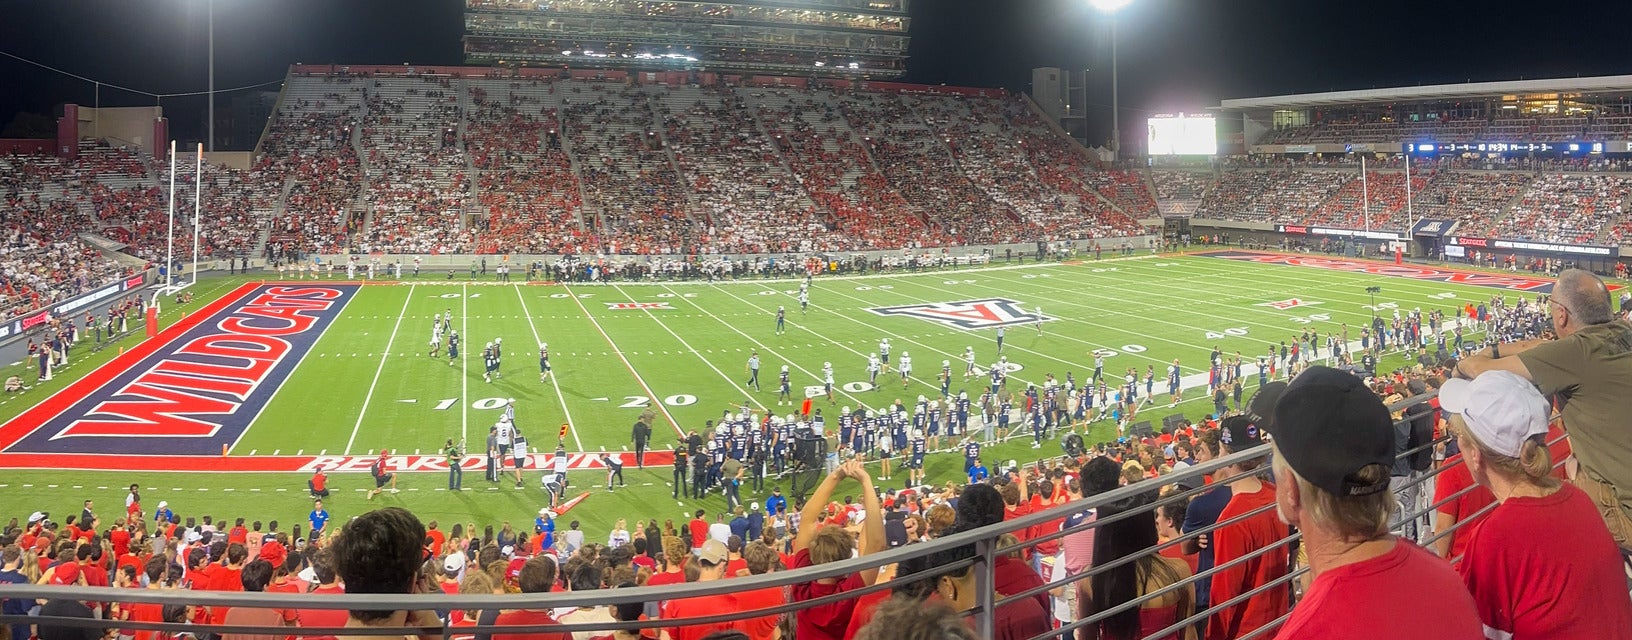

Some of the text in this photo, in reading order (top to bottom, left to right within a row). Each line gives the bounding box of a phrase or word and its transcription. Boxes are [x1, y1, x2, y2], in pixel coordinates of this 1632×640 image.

[48, 286, 344, 440] WILDCATS
[433, 397, 509, 411] 10
[619, 394, 698, 409] 20
